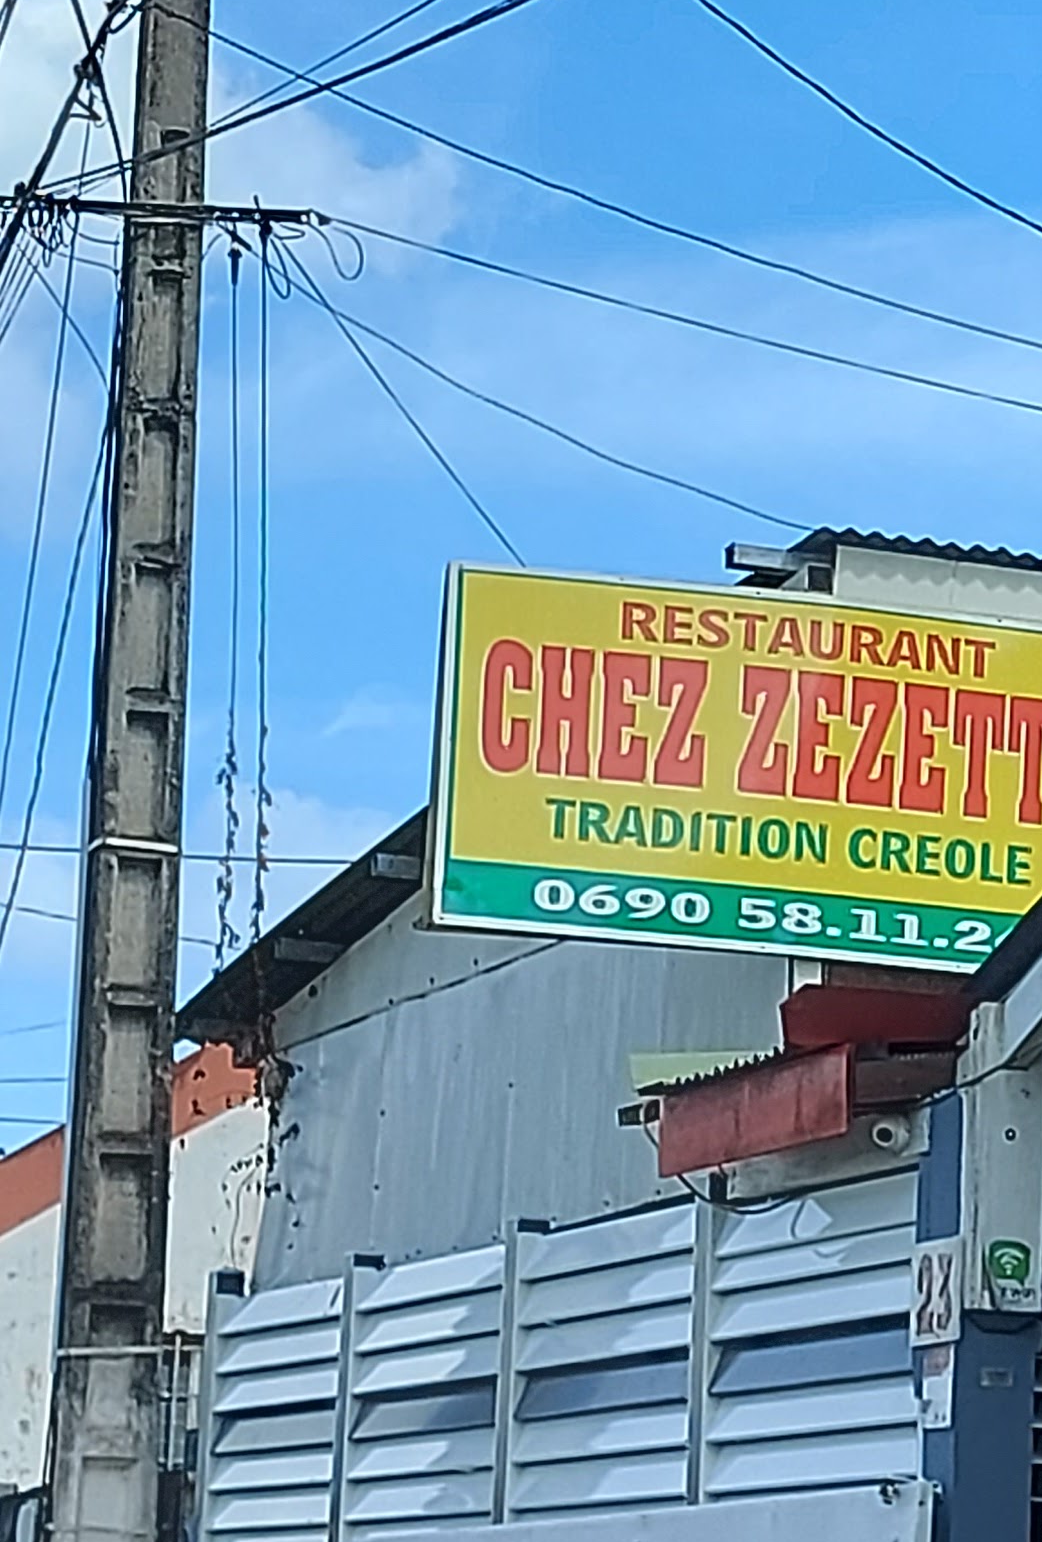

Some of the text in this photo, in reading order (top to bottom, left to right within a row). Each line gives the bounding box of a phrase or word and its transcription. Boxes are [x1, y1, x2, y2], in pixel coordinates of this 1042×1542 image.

[622, 601, 996, 678] RESTAURANT
[480, 639, 709, 789] CHEZ
[545, 797, 1034, 886] TRADITION CREOLE
[533, 878, 1014, 953] 0690 58.11.2
